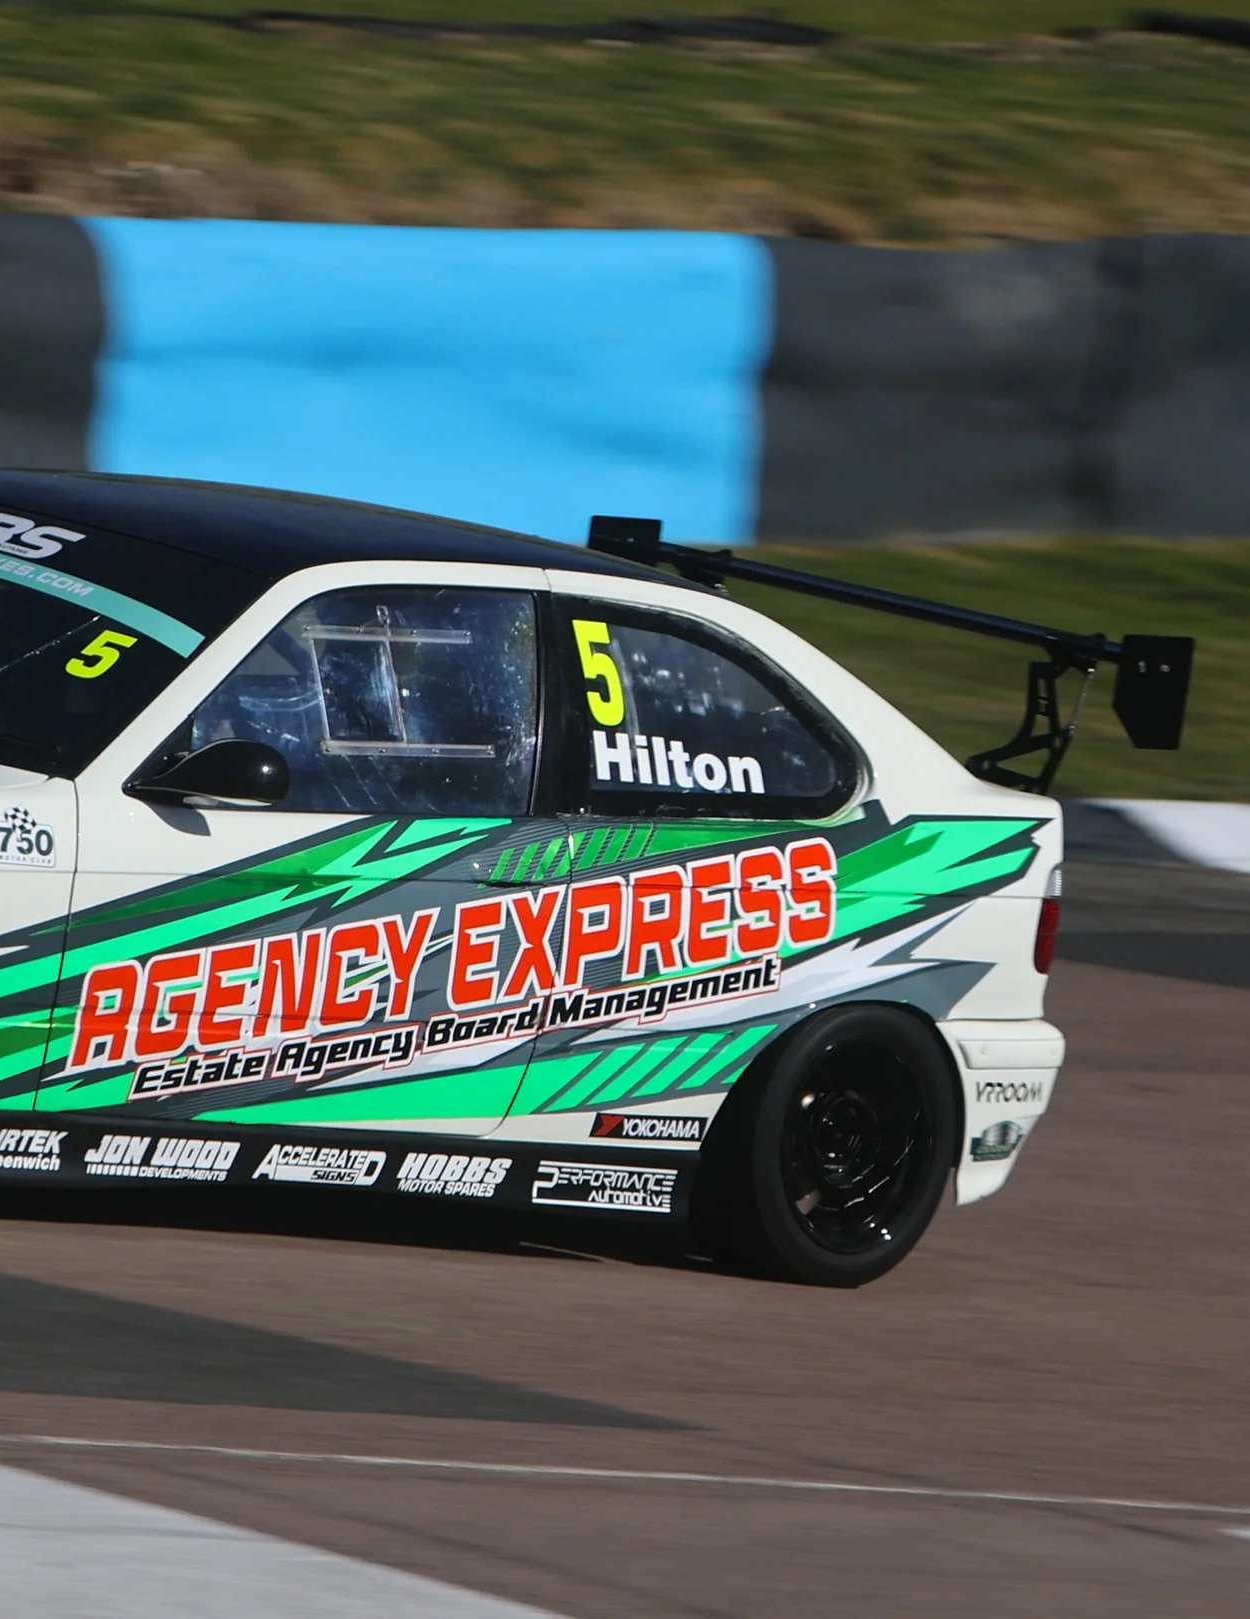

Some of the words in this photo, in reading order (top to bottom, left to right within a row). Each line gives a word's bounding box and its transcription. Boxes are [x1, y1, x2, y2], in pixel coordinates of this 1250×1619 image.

[65, 630, 139, 679] 5
[572, 619, 626, 727] 5
[592, 730, 766, 794] Hilton
[67, 907, 440, 1071] AGENCY
[450, 838, 837, 1006] EXPRESS
[132, 1054, 265, 1095] Estate
[275, 1028, 416, 1078] Agency
[426, 1001, 539, 1047] Board
[549, 957, 778, 1027] Management
[622, 1117, 701, 1139] YOKOHAMA
[84, 1134, 152, 1164] JON
[150, 1137, 241, 1170] WOOD
[251, 1143, 387, 1187] ACCELERATED
[396, 1152, 513, 1185] HOBBS
[138, 1165, 228, 1182] DEVELOPMENTS
[310, 1169, 358, 1183] SIGNS
[397, 1179, 444, 1195] MOTOR
[444, 1181, 497, 1198] SPARES
[532, 1164, 677, 1198] PERFORMANCE
